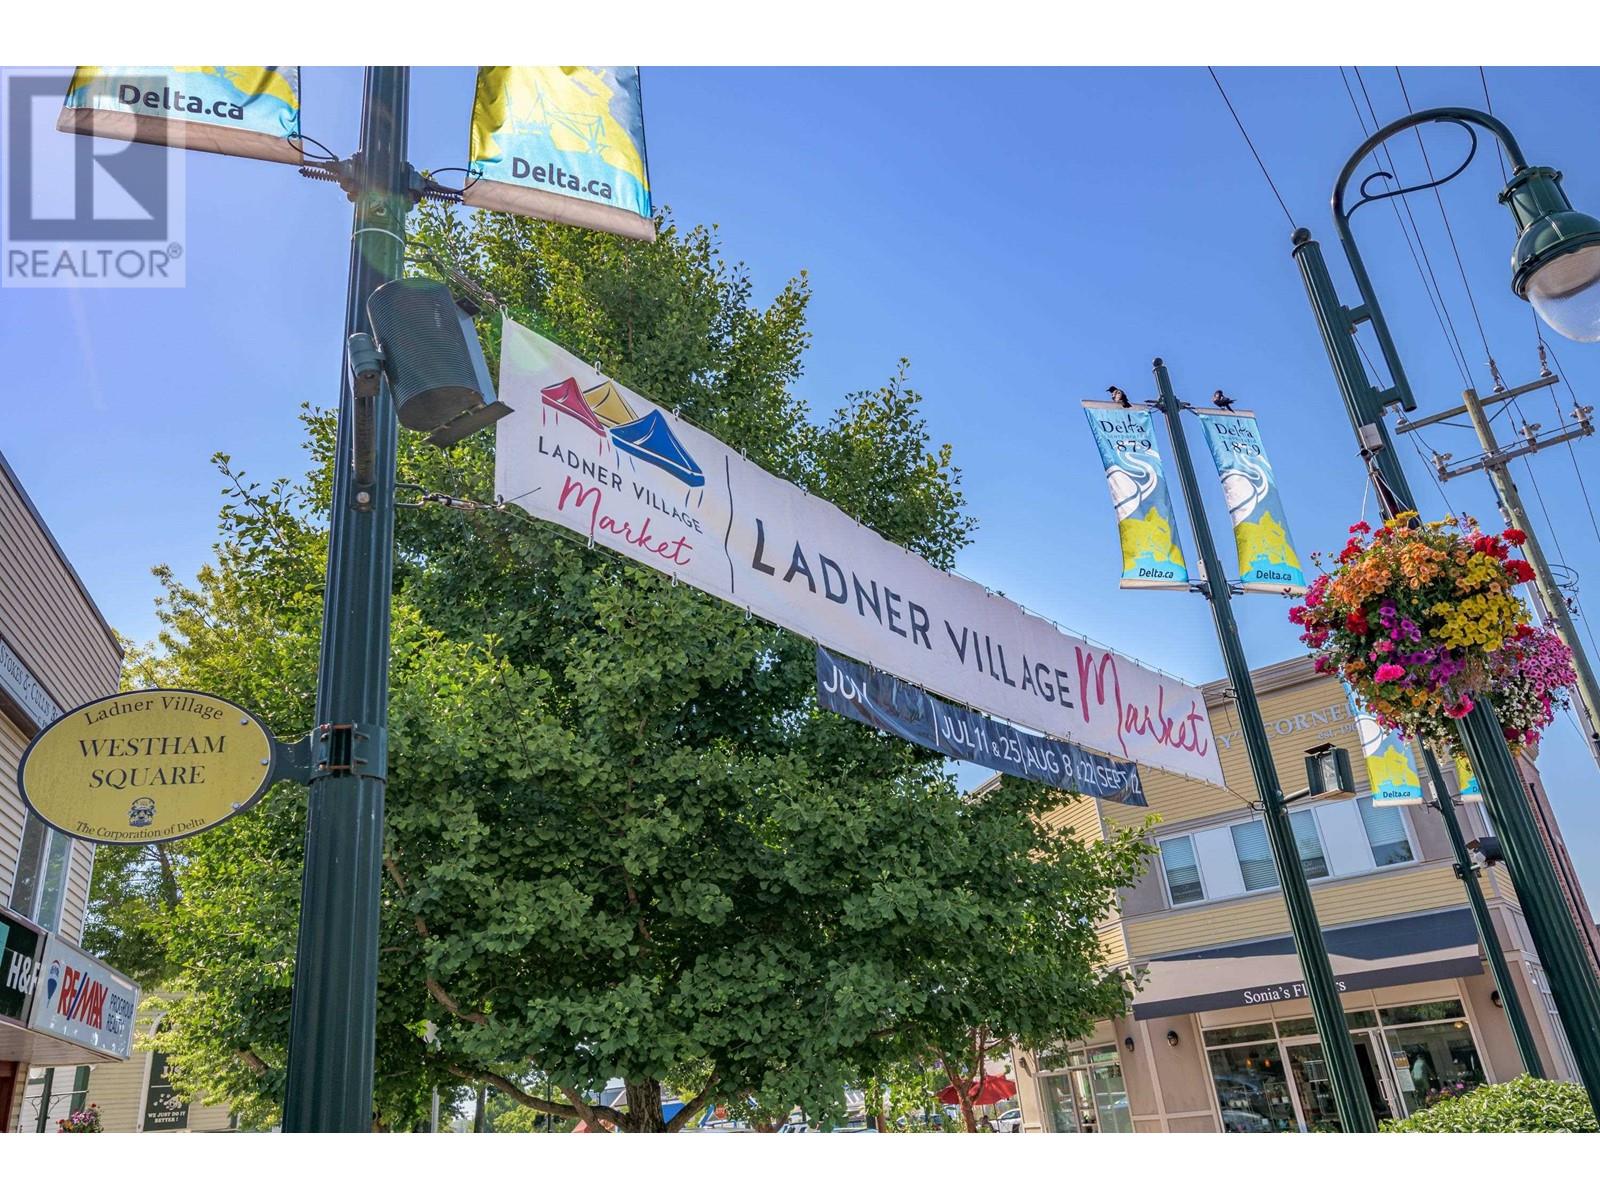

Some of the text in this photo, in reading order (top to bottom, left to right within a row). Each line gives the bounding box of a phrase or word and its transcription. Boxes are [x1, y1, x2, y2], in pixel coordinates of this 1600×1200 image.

[119, 84, 244, 120] Delta.ca
[512, 156, 612, 199] Delta.ca
[1100, 414, 1145, 433] Delta
[1215, 419, 1253, 438] Delta
[1107, 439, 1152, 452] 1879
[1222, 440, 1261, 455] 1879
[538, 436, 703, 534] LADNER VILLAGE
[558, 476, 693, 565] Market
[1138, 568, 1174, 579] Delta.ca
[1256, 570, 1292, 581] Delta.ca
[752, 518, 1208, 758] LADNER VILLAGE Market
[84, 700, 154, 726] Ladner
[161, 695, 224, 720] Village
[80, 735, 226, 758] WESTHAM
[941, 715, 975, 748] JUL
[1027, 746, 1059, 774] AUG
[1062, 754, 1073, 777] 8
[89, 765, 206, 790] SQUARE
[1382, 791, 1411, 799] Delta.ca
[76, 818, 206, 840] The Corporation of Delta
[57, 965, 109, 1030] RE/MAX
[1243, 987, 1291, 1004] Sonia's
